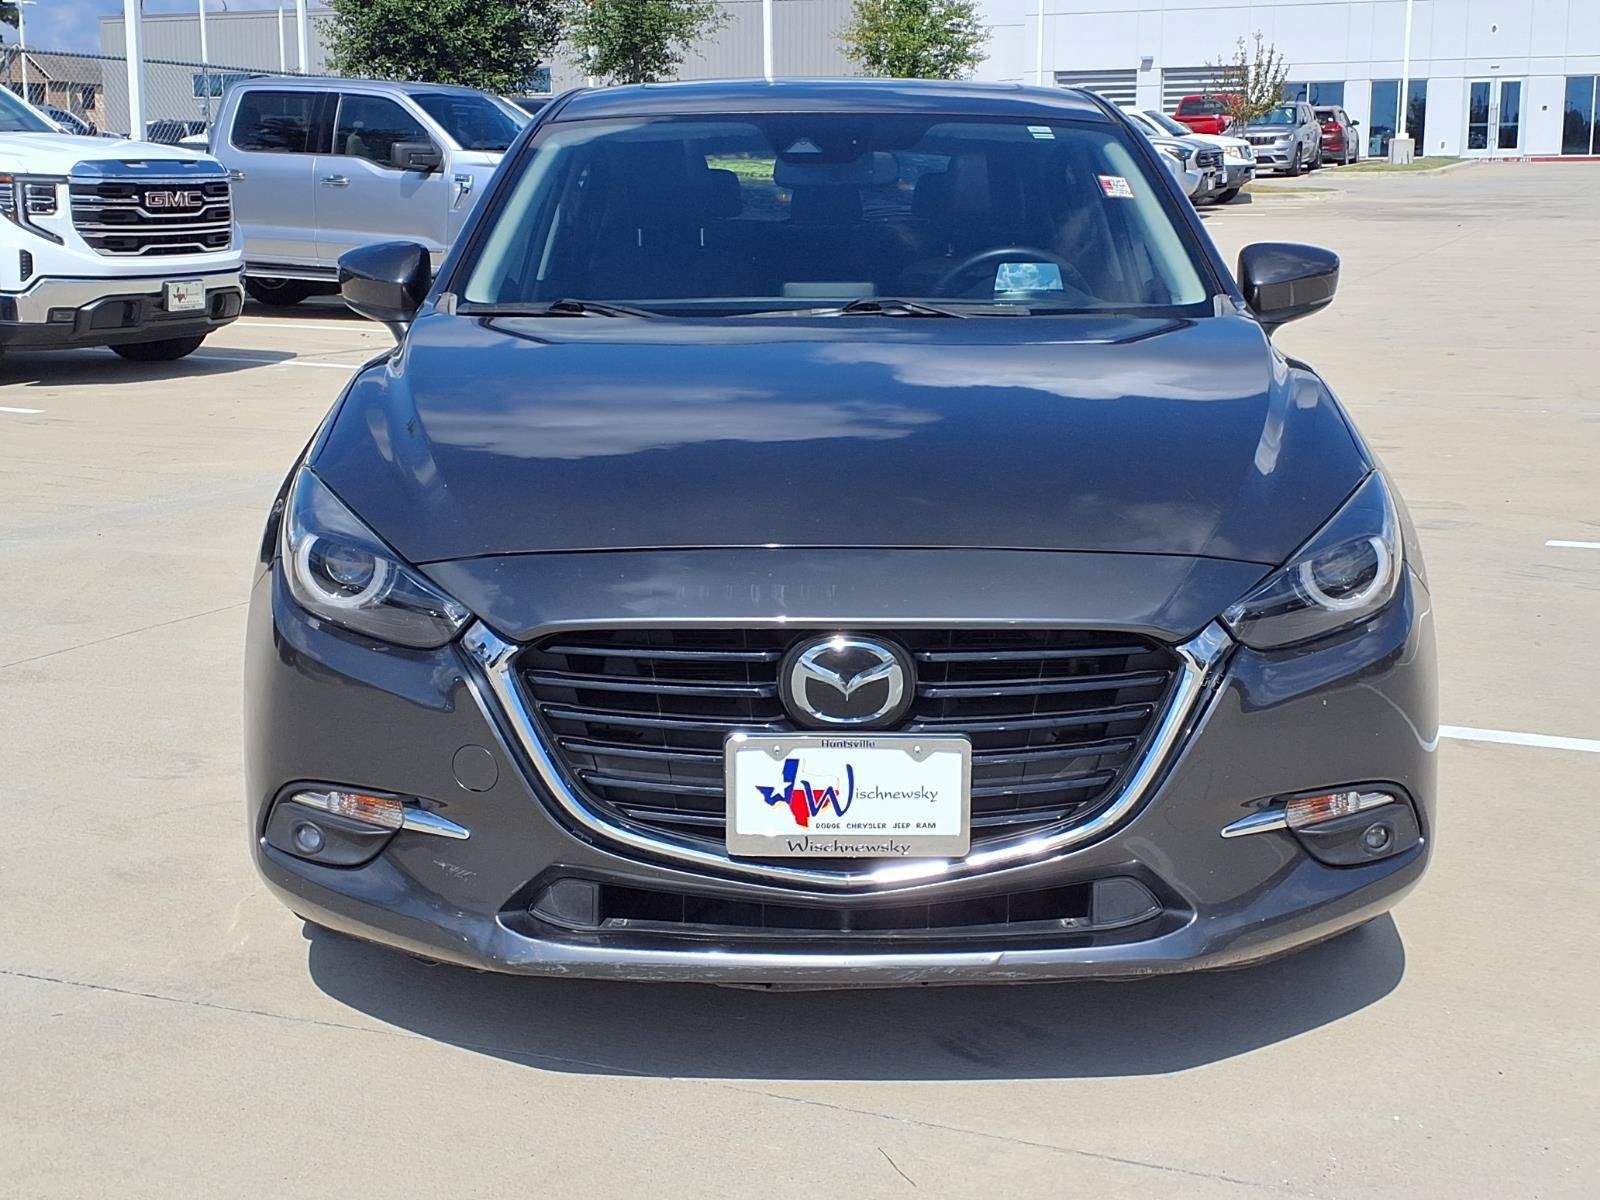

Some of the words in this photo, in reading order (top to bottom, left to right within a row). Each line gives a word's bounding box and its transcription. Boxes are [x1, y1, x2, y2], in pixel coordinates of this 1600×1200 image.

[144, 190, 202, 207] GMC
[821, 739, 876, 749] Huntsville
[800, 763, 939, 817] Wischnewsky
[787, 836, 911, 855] Wischnewsky
